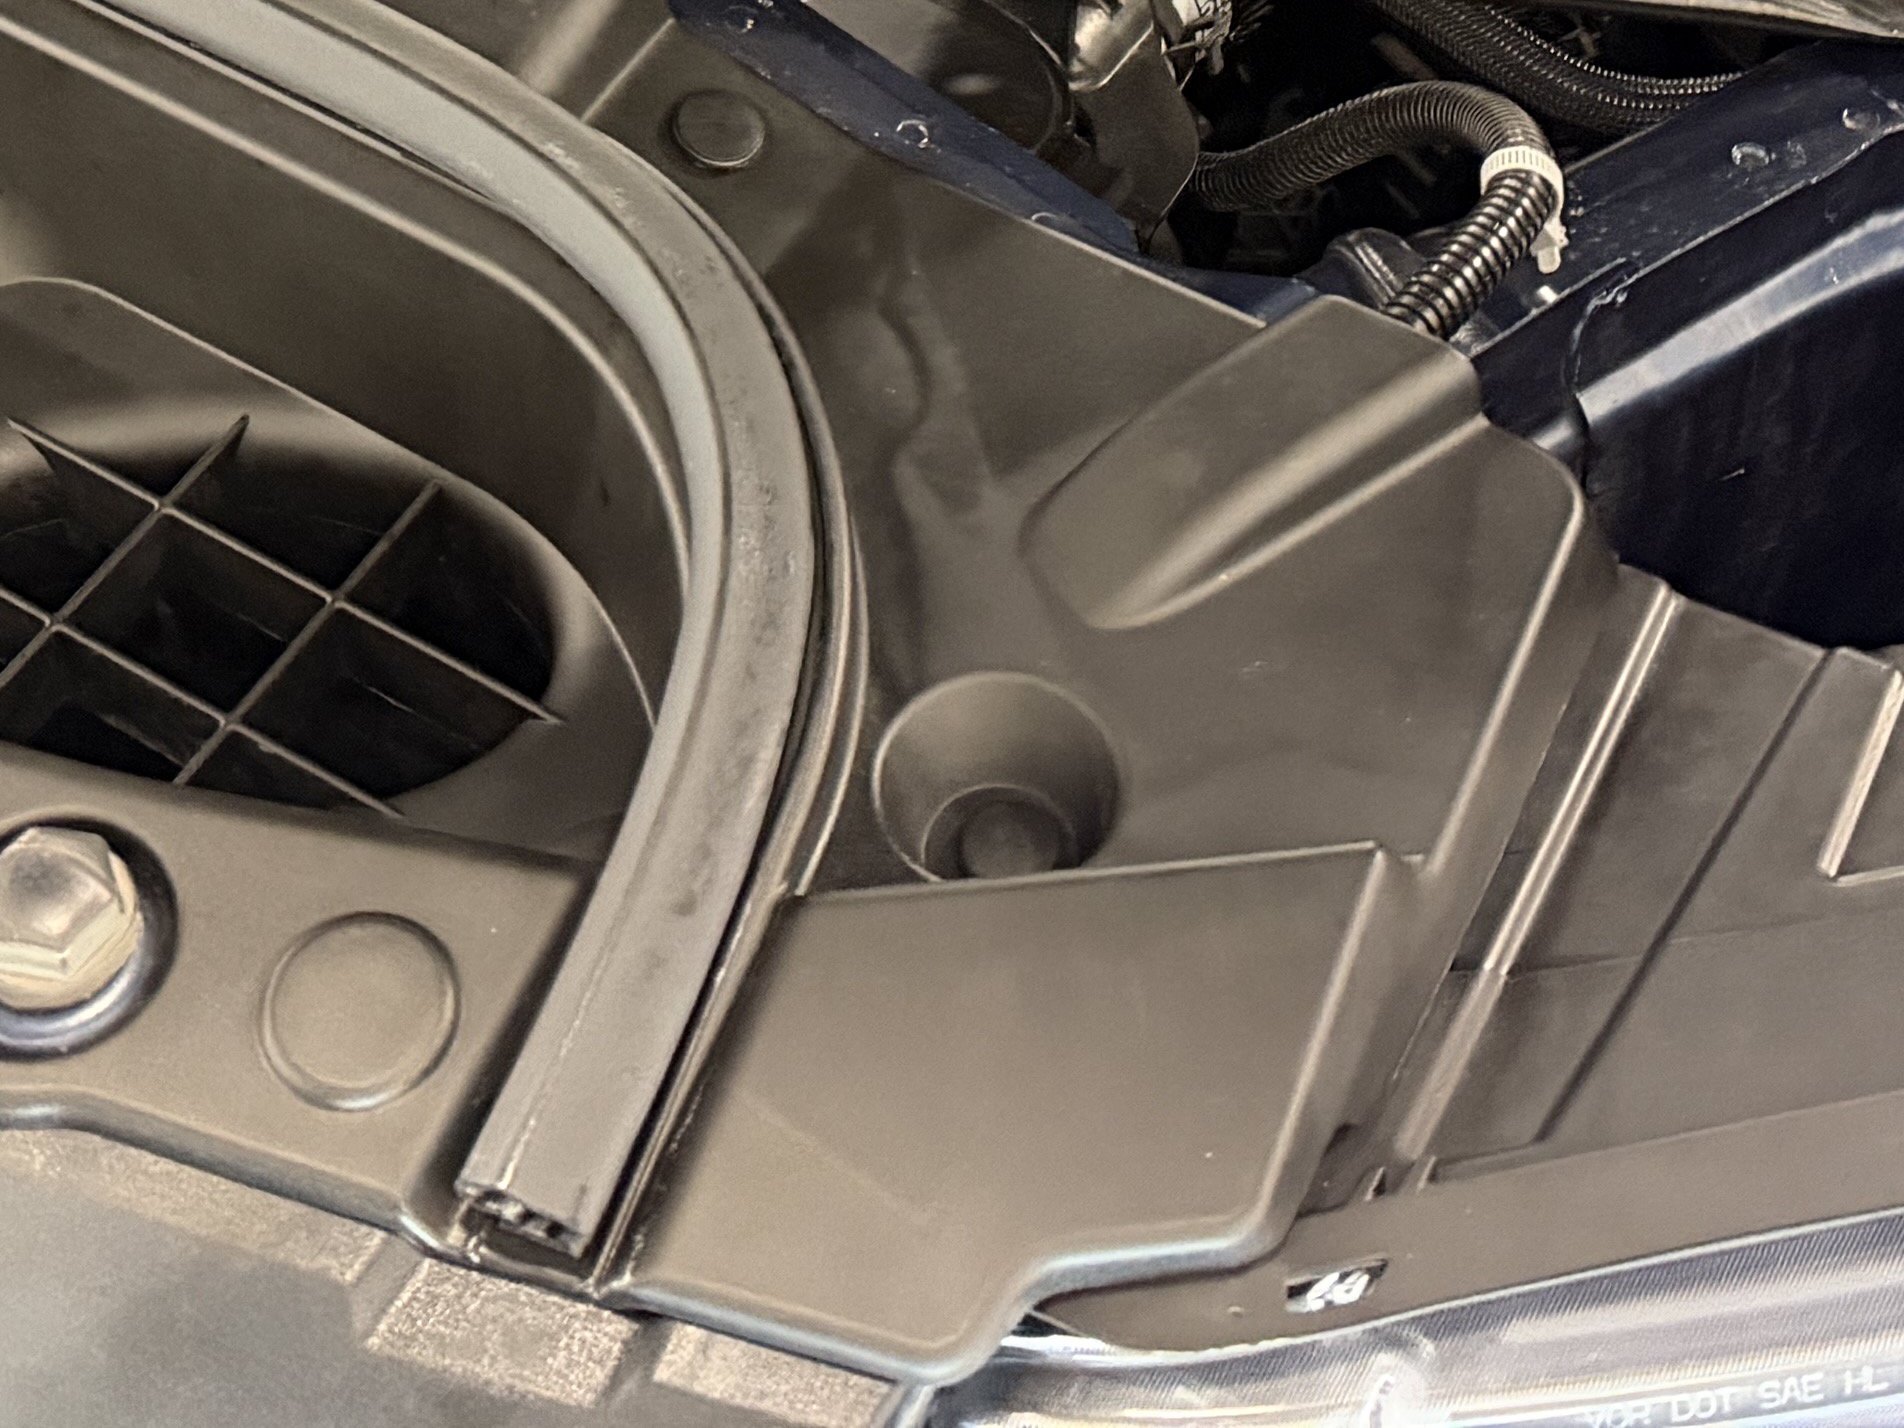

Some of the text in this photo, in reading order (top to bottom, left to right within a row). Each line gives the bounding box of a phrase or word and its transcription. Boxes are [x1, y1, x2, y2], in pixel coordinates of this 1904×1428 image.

[1671, 1386, 1738, 1423] DOT
[1757, 1372, 1825, 1410] SAE
[1845, 1365, 1890, 1396] HL
